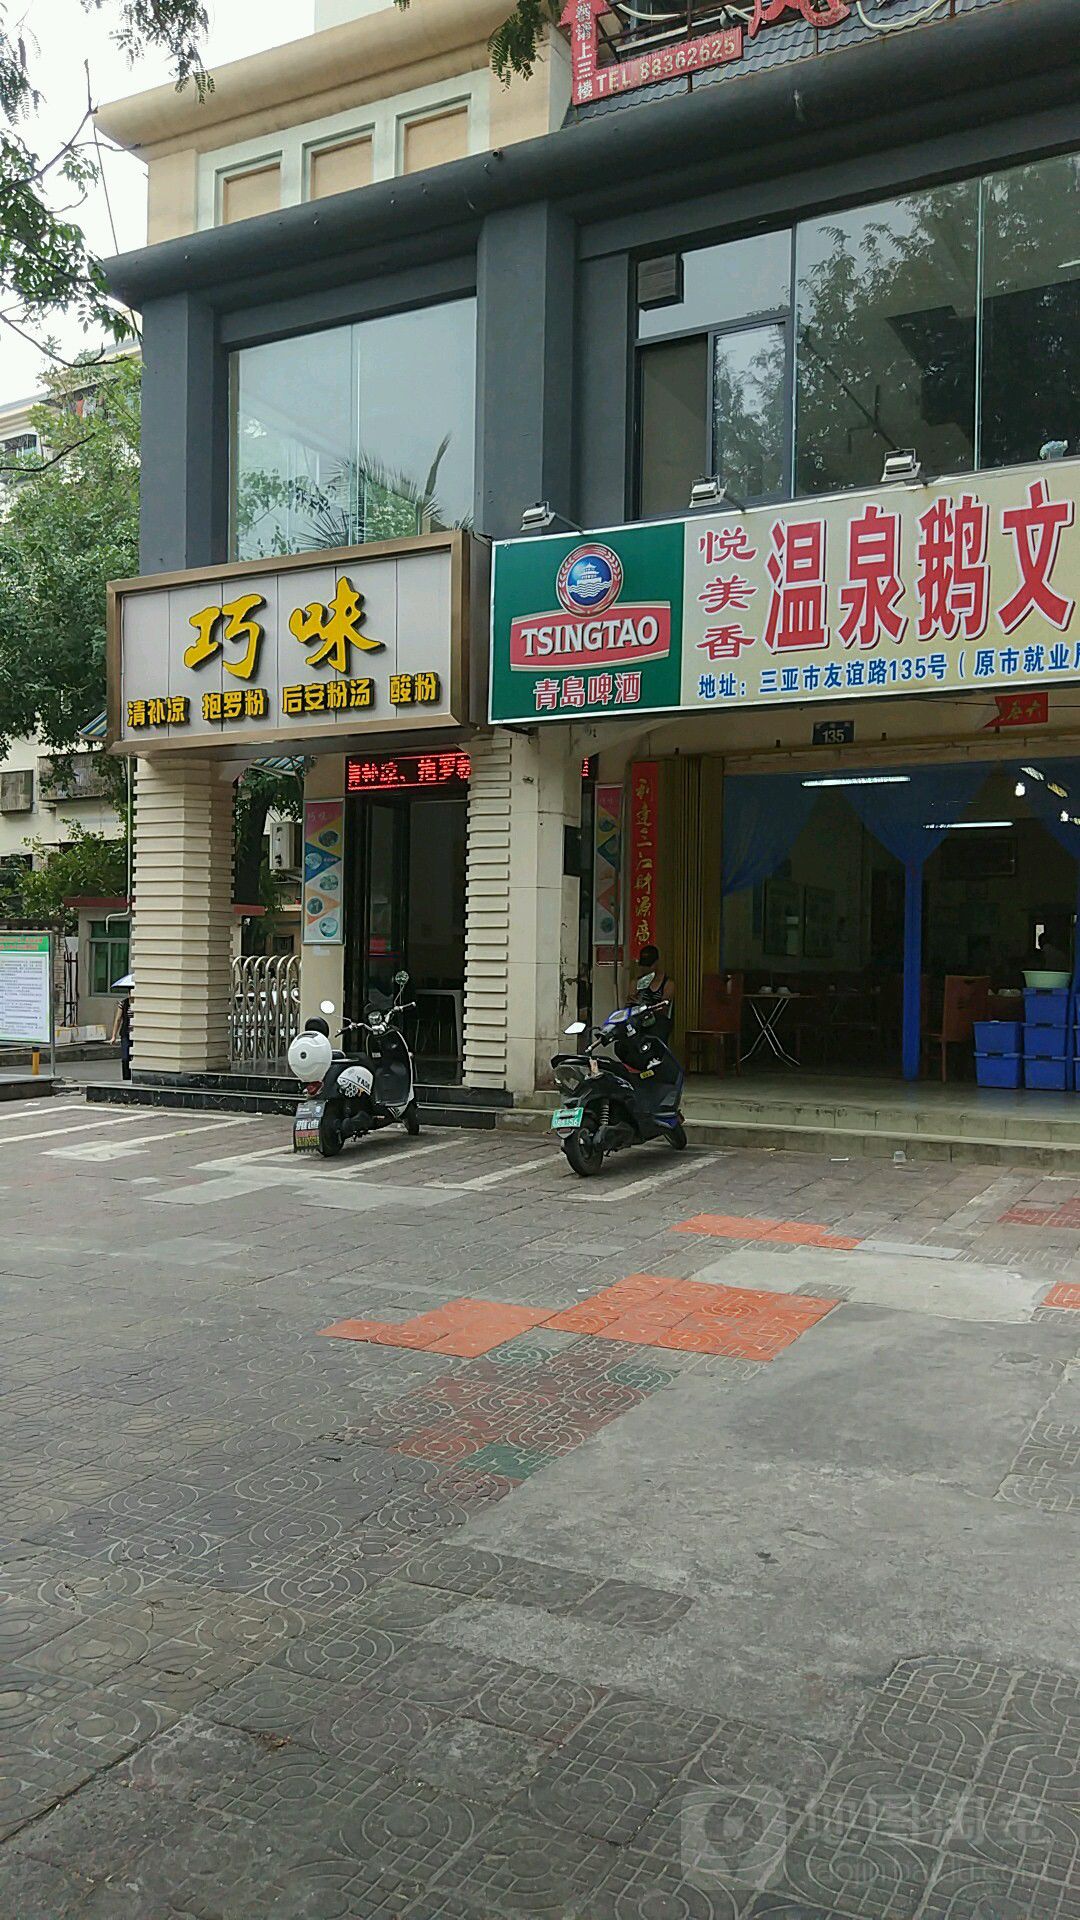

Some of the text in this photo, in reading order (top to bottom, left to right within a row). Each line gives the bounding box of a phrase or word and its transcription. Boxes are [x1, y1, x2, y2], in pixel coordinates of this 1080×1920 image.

[639, 37, 737, 80] 88362625
[763, 477, 1075, 654] 温泉鹅文
[696, 527, 757, 661] 悦美香
[184, 575, 385, 680] 巧味
[520, 615, 660, 658] TSINGTAO
[127, 672, 440, 728] 清补凉 抱罗粉 后安粉汤 酸粉
[822, 729, 845, 744] 135
